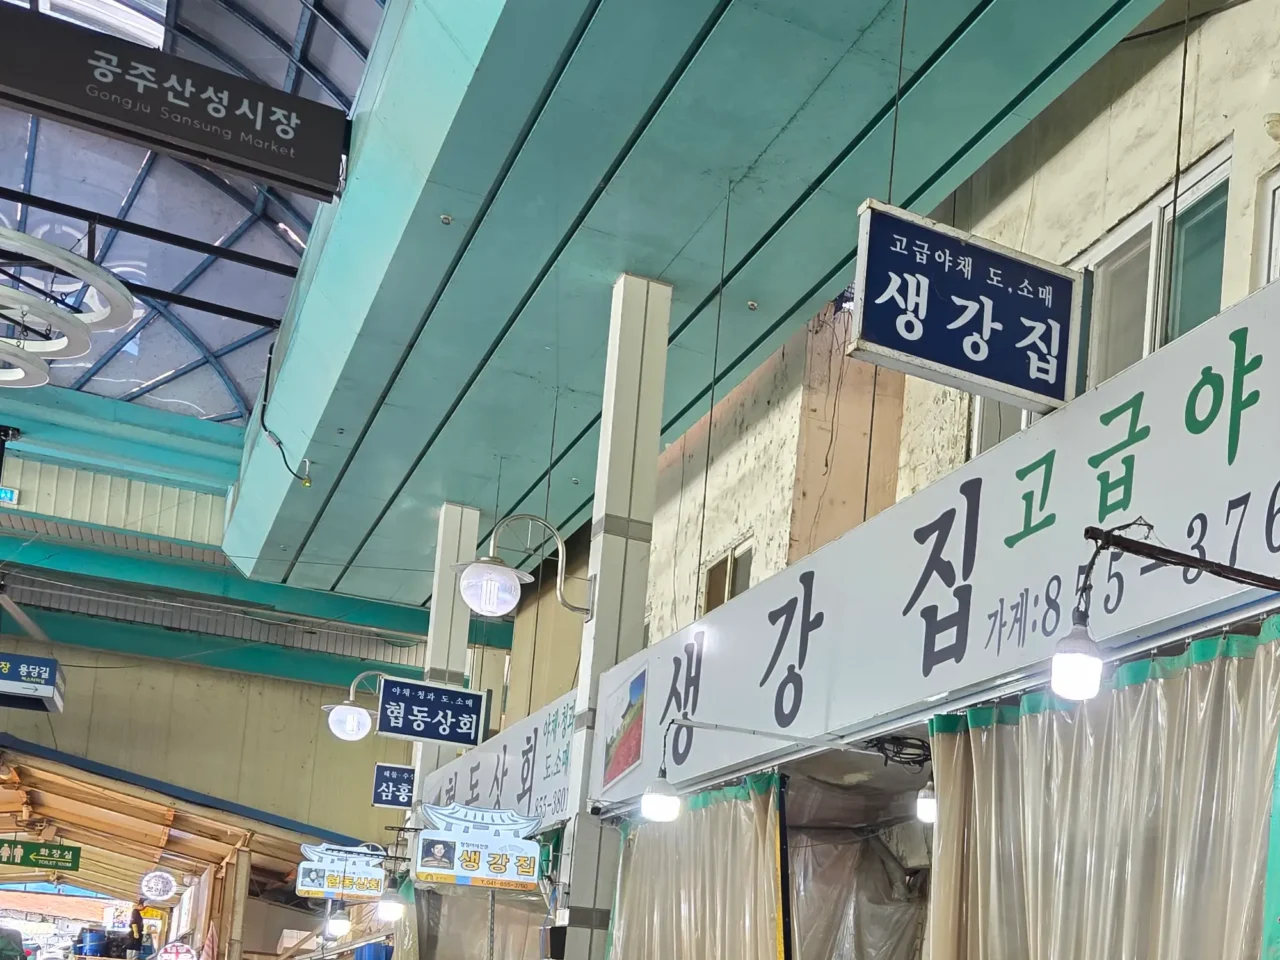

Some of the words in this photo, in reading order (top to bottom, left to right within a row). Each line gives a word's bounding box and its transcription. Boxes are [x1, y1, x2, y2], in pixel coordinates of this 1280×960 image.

[87, 50, 301, 140] 공주산성시장
[85, 84, 151, 113] Gongju
[160, 107, 232, 140] Sansung
[239, 131, 296, 158] Market
[889, 233, 973, 281] 고급야채
[874, 271, 1061, 384] 생강집
[660, 477, 983, 767] 생강집
[18, 664, 50, 679] 용당길
[384, 701, 477, 740] 협동상회
[39, 847, 73, 860] 화장실
[458, 850, 536, 876] 생강집
